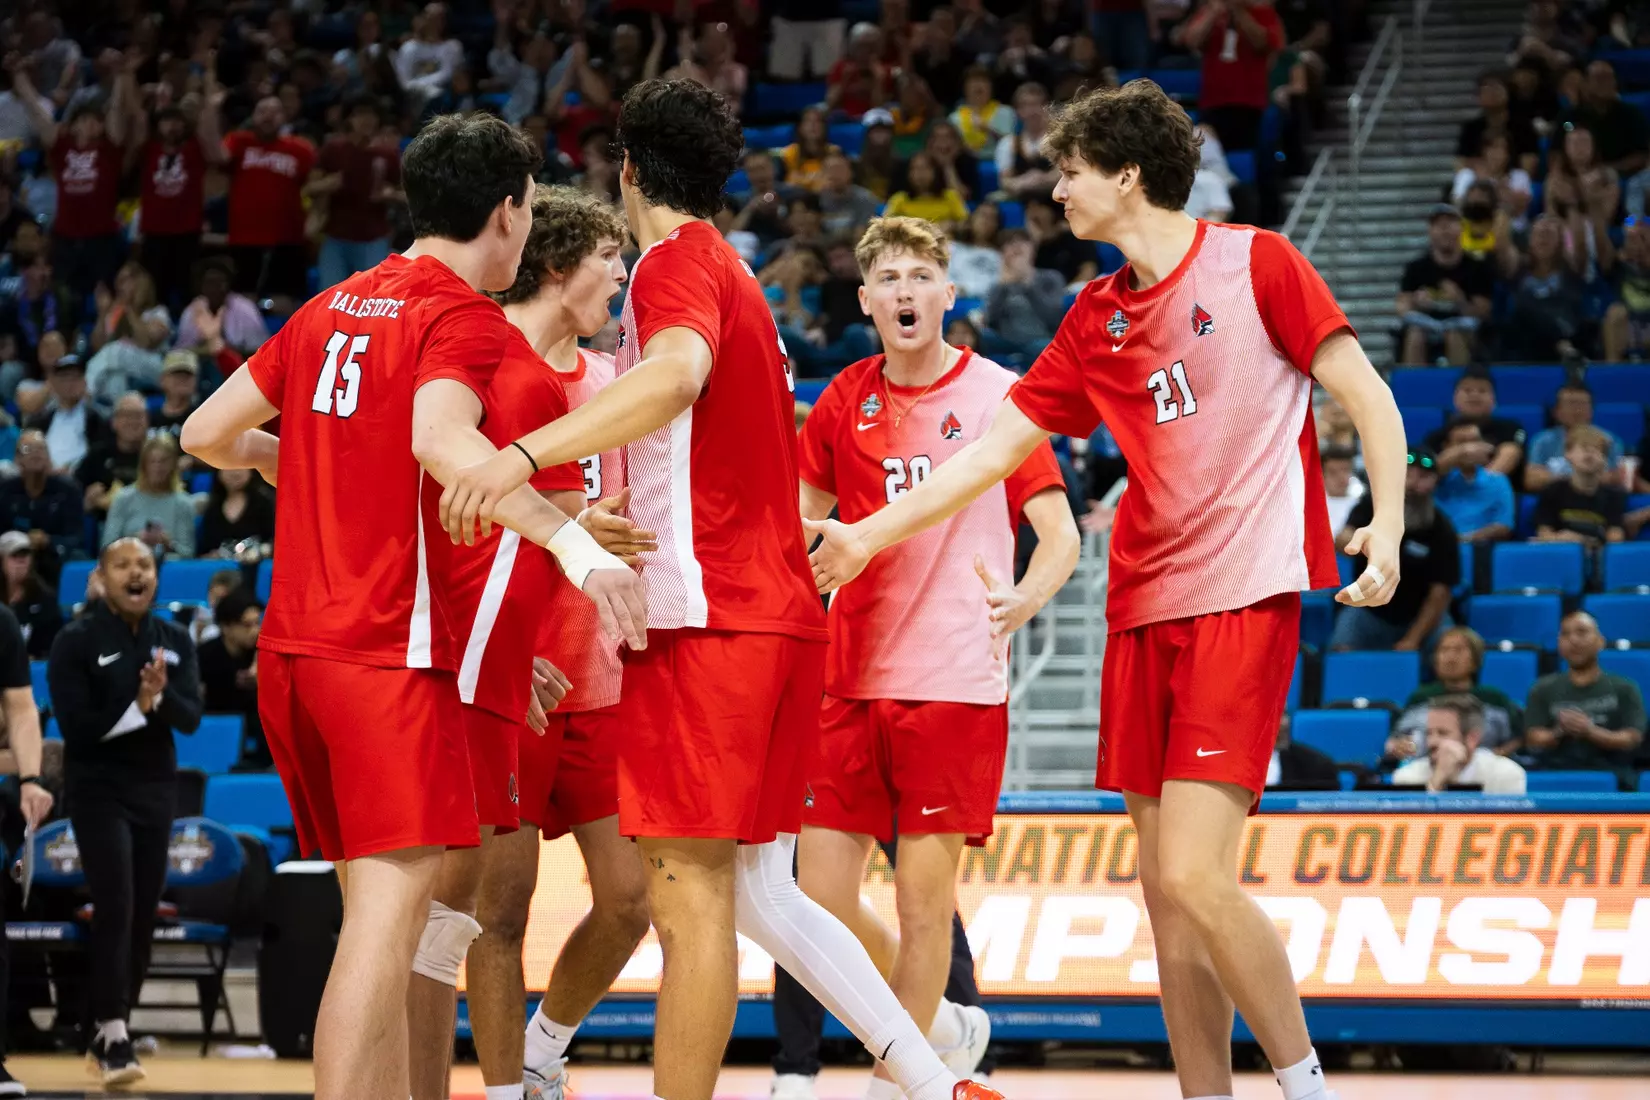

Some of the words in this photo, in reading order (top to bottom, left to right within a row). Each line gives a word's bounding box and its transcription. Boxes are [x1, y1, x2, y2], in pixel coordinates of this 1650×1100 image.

[311, 329, 372, 419] 15
[1147, 359, 1198, 425] 21
[881, 454, 933, 505] 20
[961, 824, 1267, 884] NATIOL
[1294, 824, 1650, 885] COLLEGIAT
